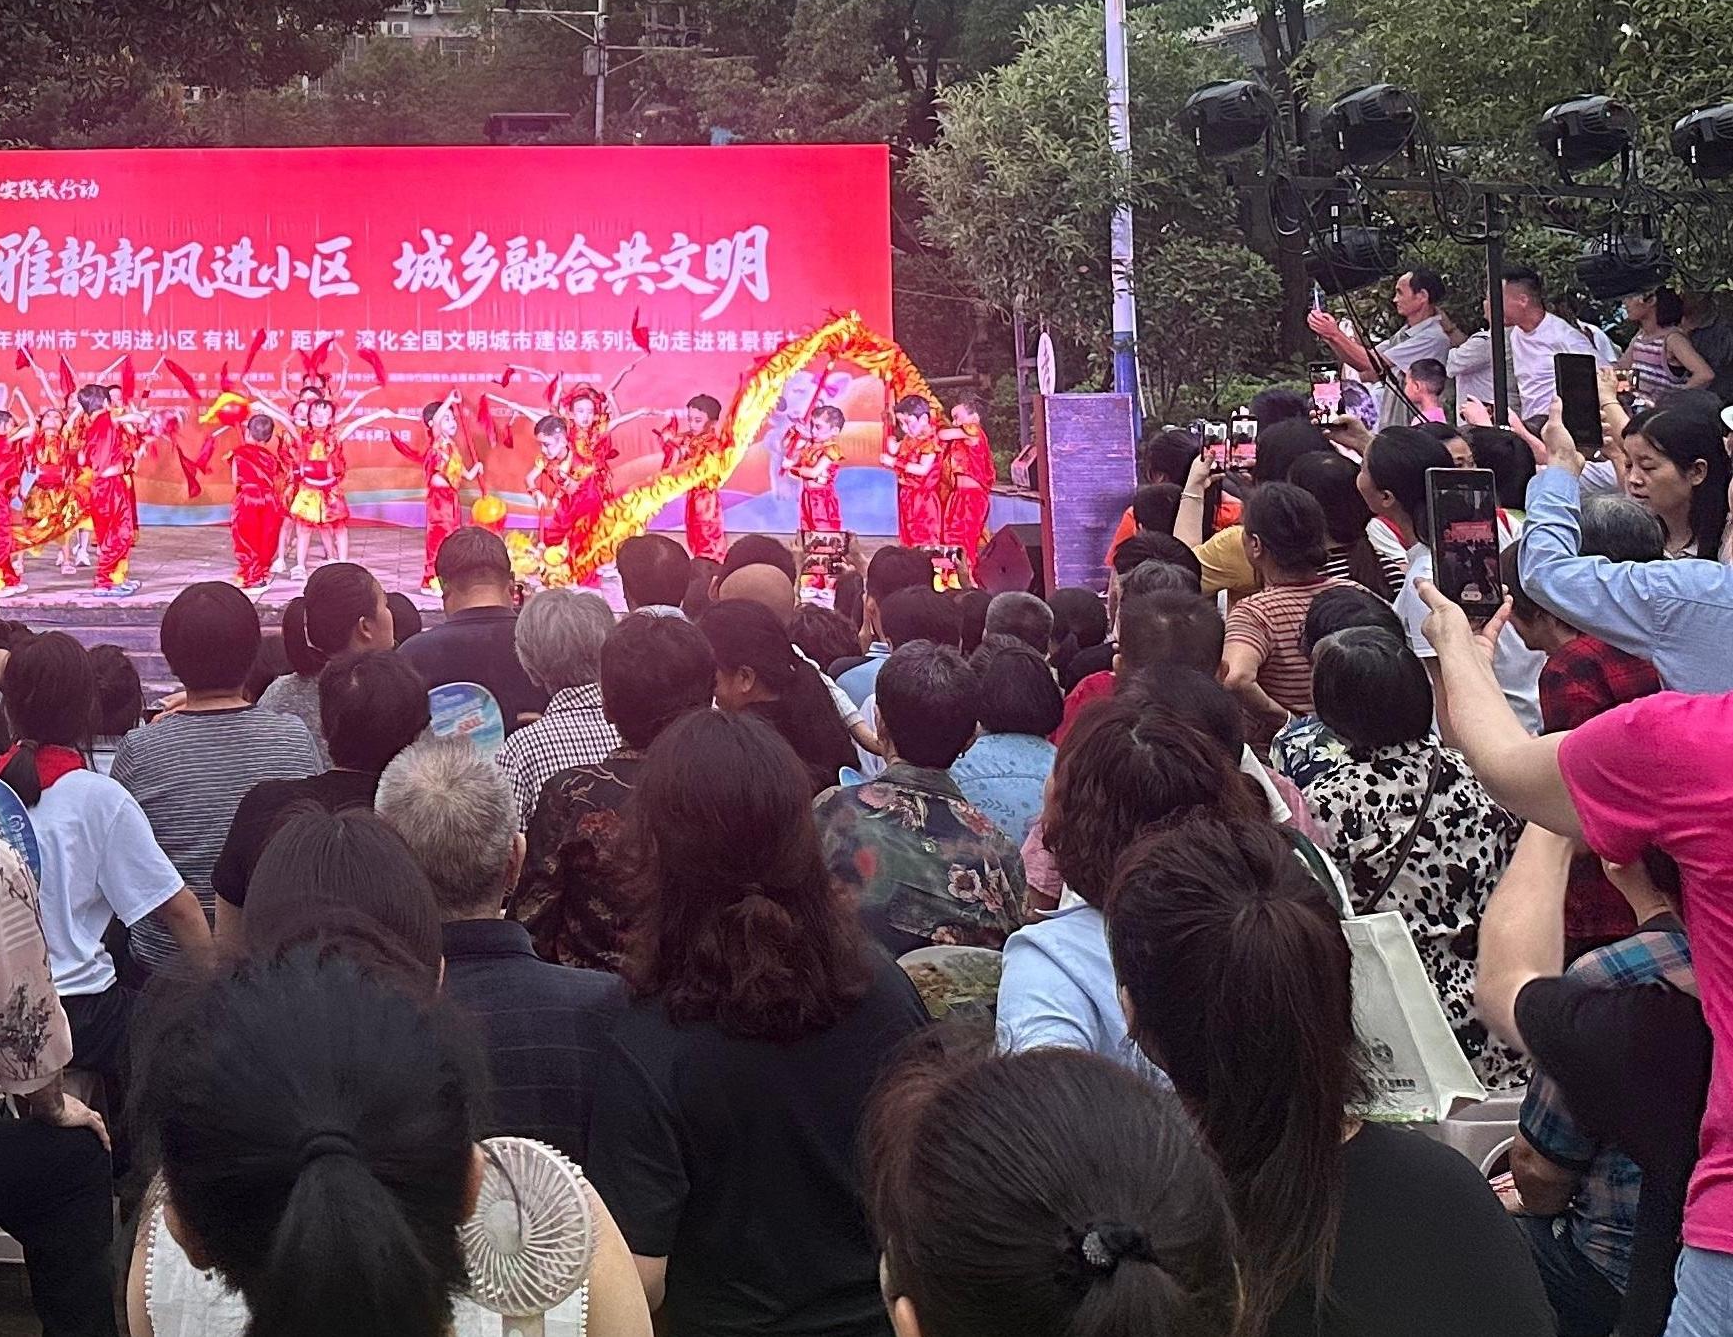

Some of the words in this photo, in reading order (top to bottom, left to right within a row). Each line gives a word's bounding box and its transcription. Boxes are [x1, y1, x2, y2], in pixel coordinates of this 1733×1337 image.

[393, 224, 770, 321] 城乡融合共文明
[356, 329, 800, 352] 深化全国文明城市建设系列动走进雅景新
